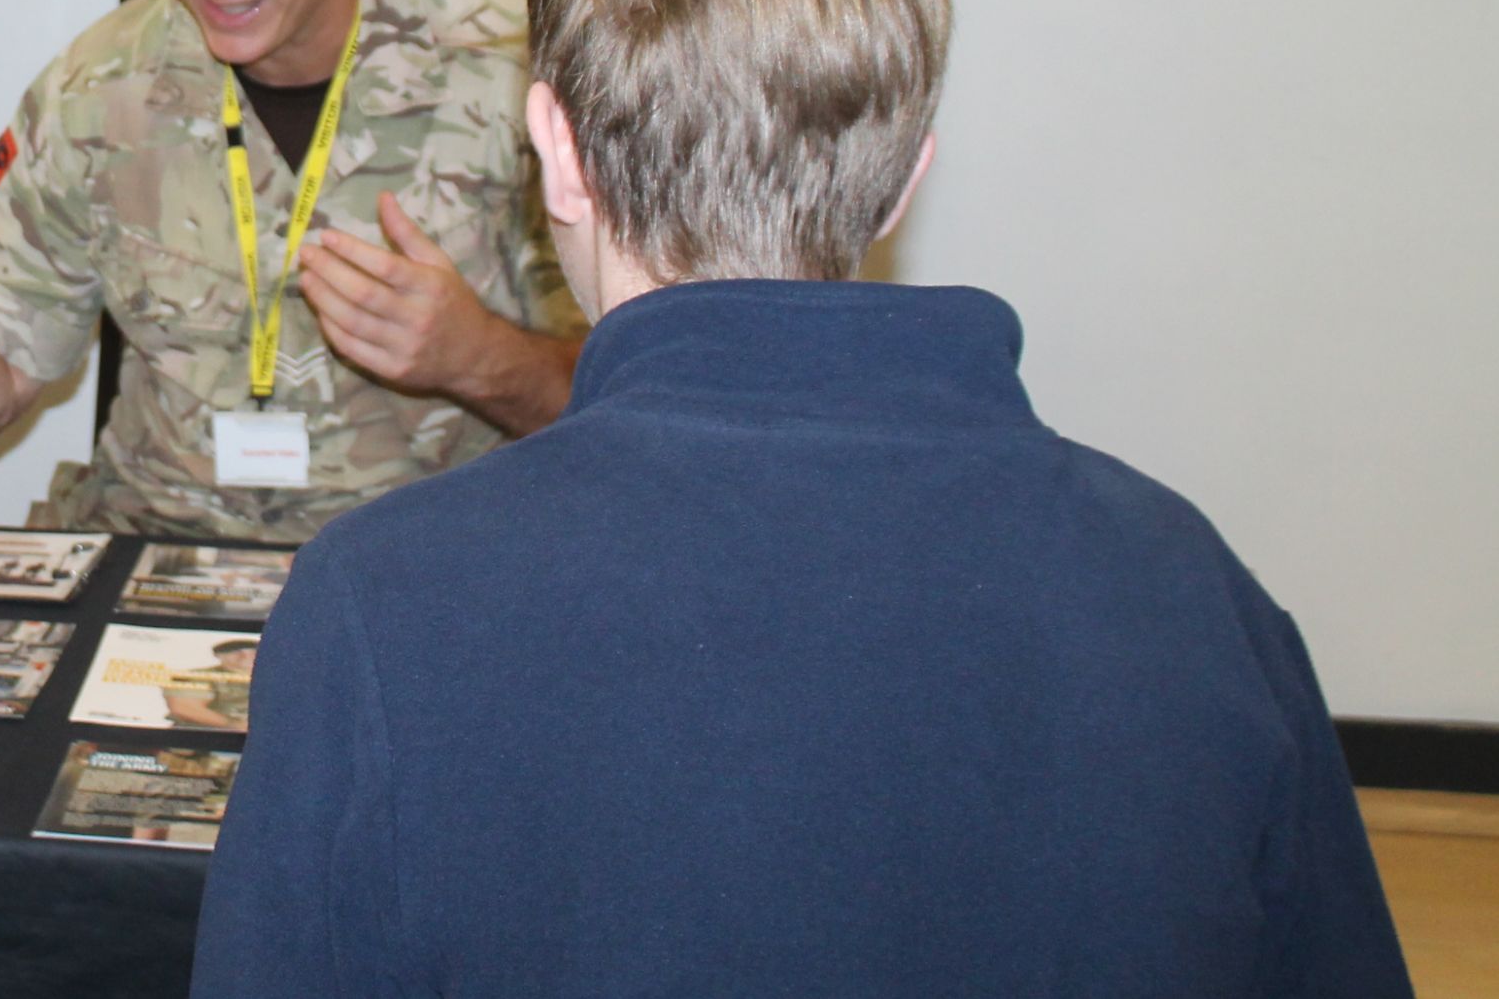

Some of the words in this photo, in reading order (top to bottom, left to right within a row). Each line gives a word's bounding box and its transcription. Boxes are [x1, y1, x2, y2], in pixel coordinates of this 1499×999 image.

[318, 100, 338, 149] VISITOR
[296, 175, 316, 224] VISITOR
[120, 762, 169, 774] ARMY
